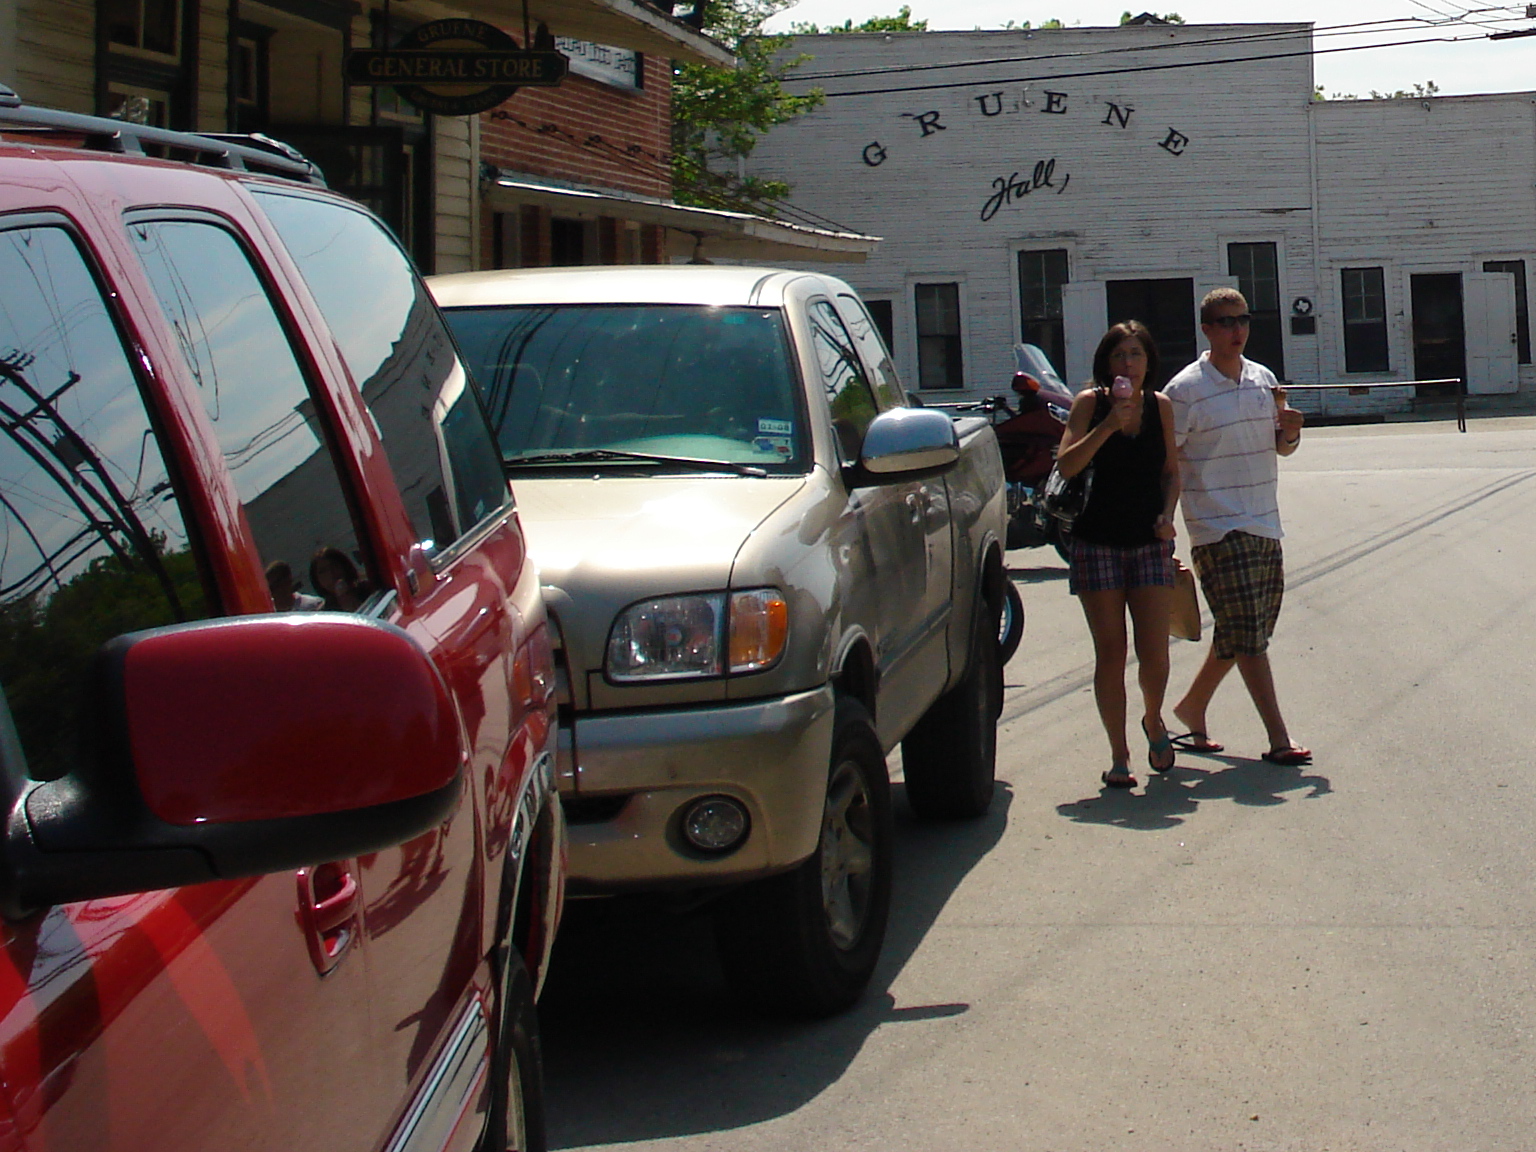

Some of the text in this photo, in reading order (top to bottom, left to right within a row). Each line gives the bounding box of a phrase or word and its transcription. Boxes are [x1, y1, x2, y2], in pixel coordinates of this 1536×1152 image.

[417, 23, 487, 42] GRUENE
[367, 56, 543, 78] GENERAL STORE
[861, 90, 1190, 168] GRUENE
